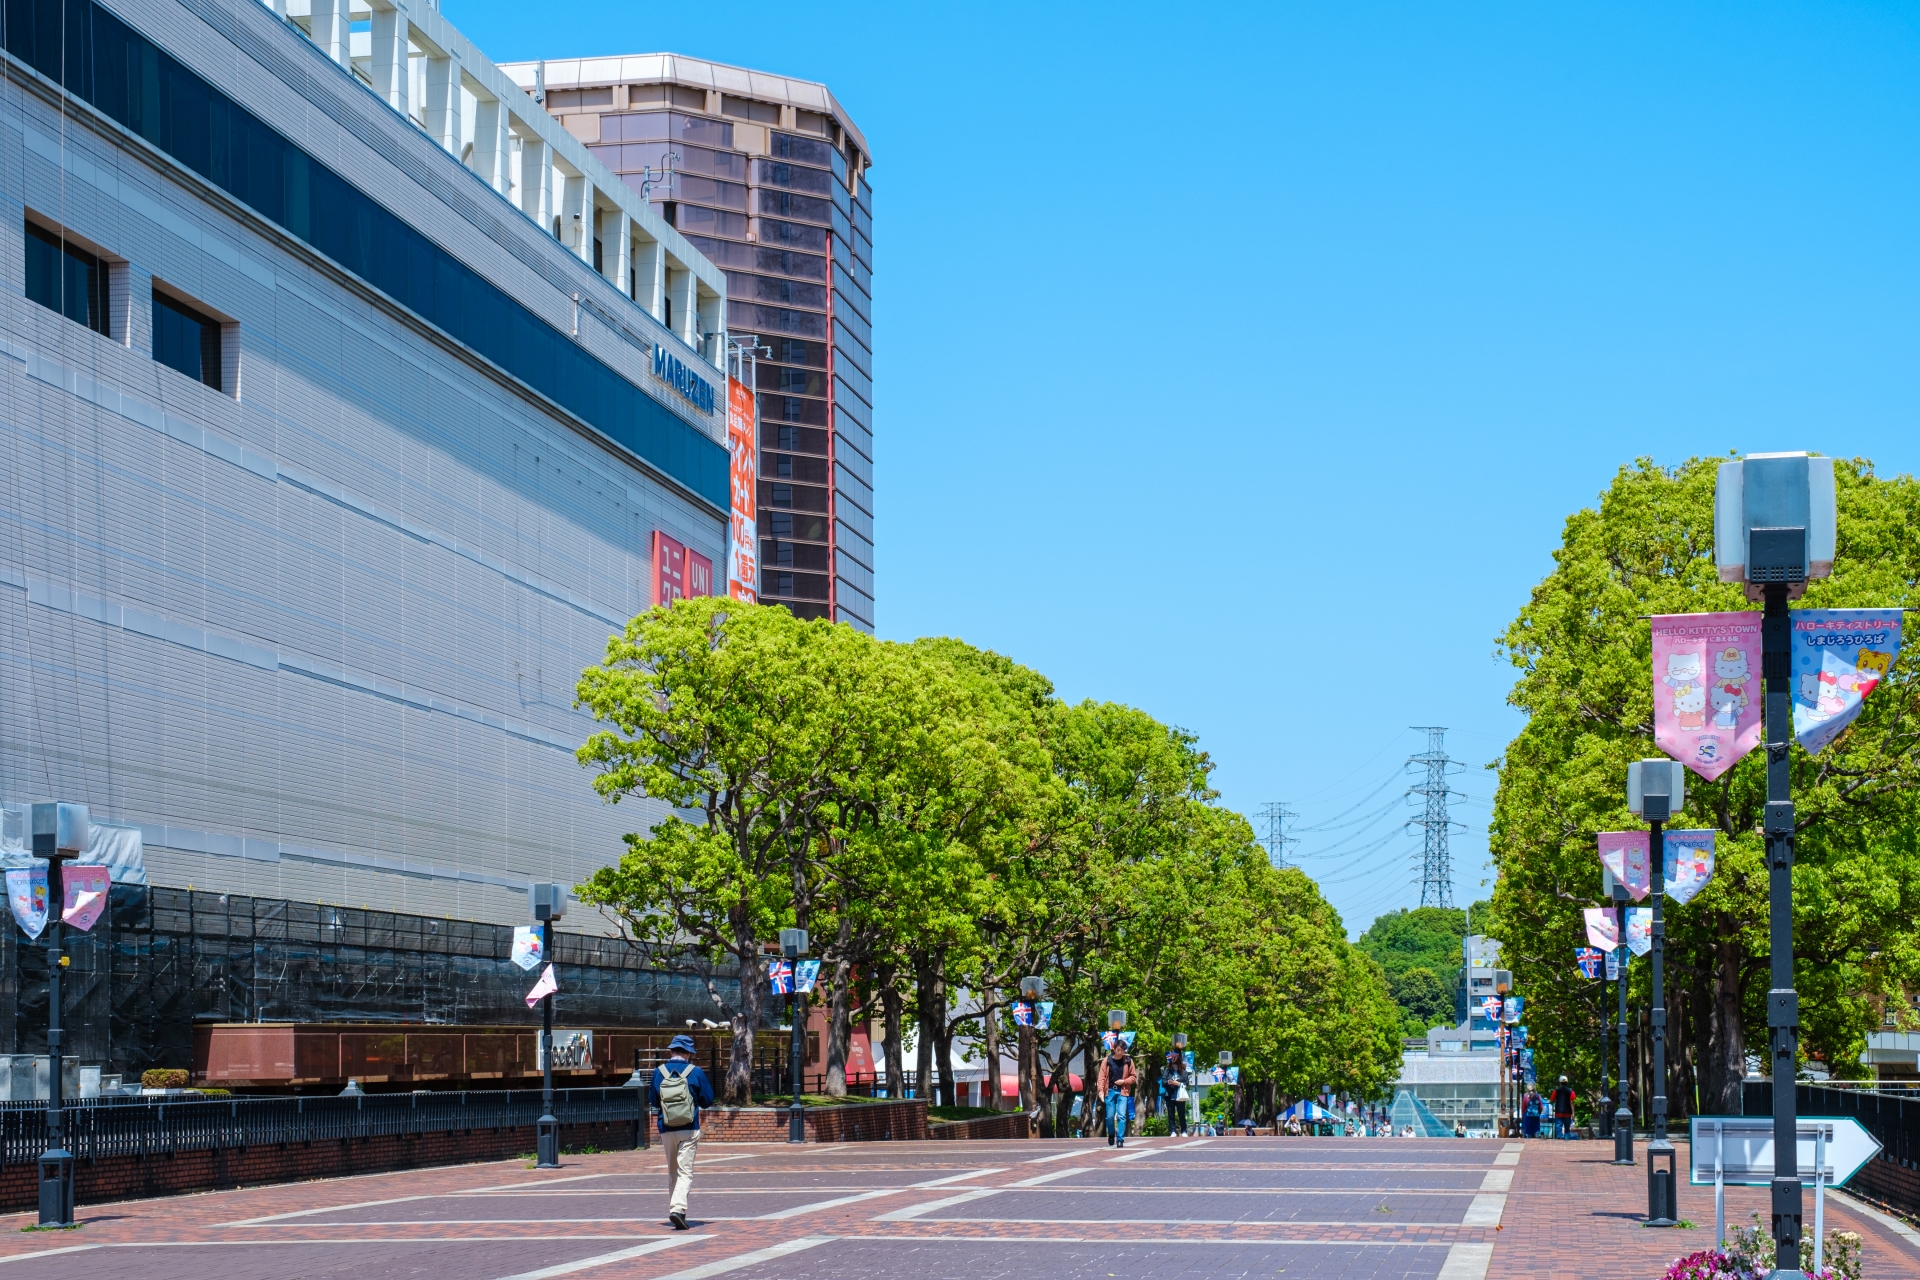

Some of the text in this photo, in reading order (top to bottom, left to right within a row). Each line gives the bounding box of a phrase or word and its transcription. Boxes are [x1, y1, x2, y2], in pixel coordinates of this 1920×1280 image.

[652, 342, 714, 417] MARUZEN
[733, 474, 750, 512] カード
[662, 545, 681, 580] ユニ
[692, 560, 709, 595] UNI
[1655, 625, 1758, 637] HELLO KITTY'S TOWN
[1795, 620, 1899, 630] ハローキティストリート
[1806, 633, 1886, 646] しまじろうひろば
